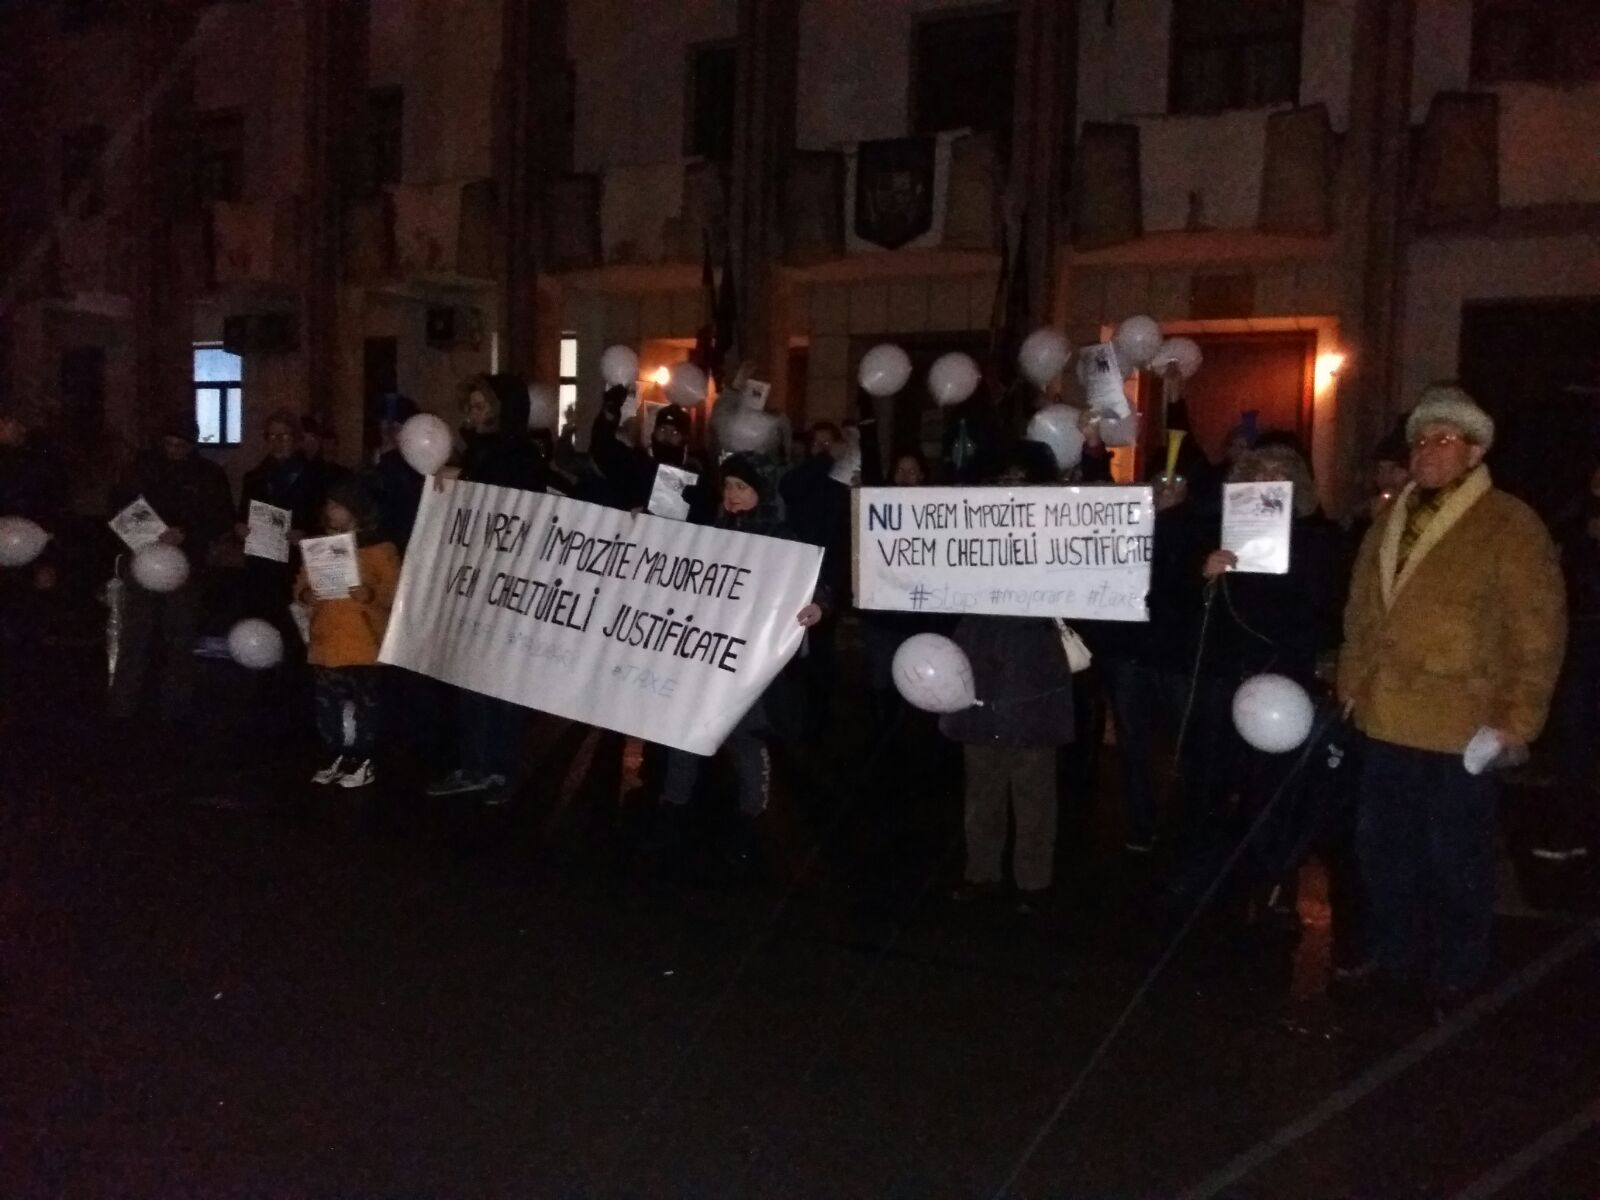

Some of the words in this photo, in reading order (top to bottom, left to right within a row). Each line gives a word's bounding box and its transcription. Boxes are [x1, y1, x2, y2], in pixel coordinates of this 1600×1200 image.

[869, 503, 902, 531] NU
[912, 503, 958, 529] VREM
[1044, 502, 1142, 527] MAJORATE
[878, 537, 936, 567] VREM
[632, 547, 752, 601] MAJORATE
